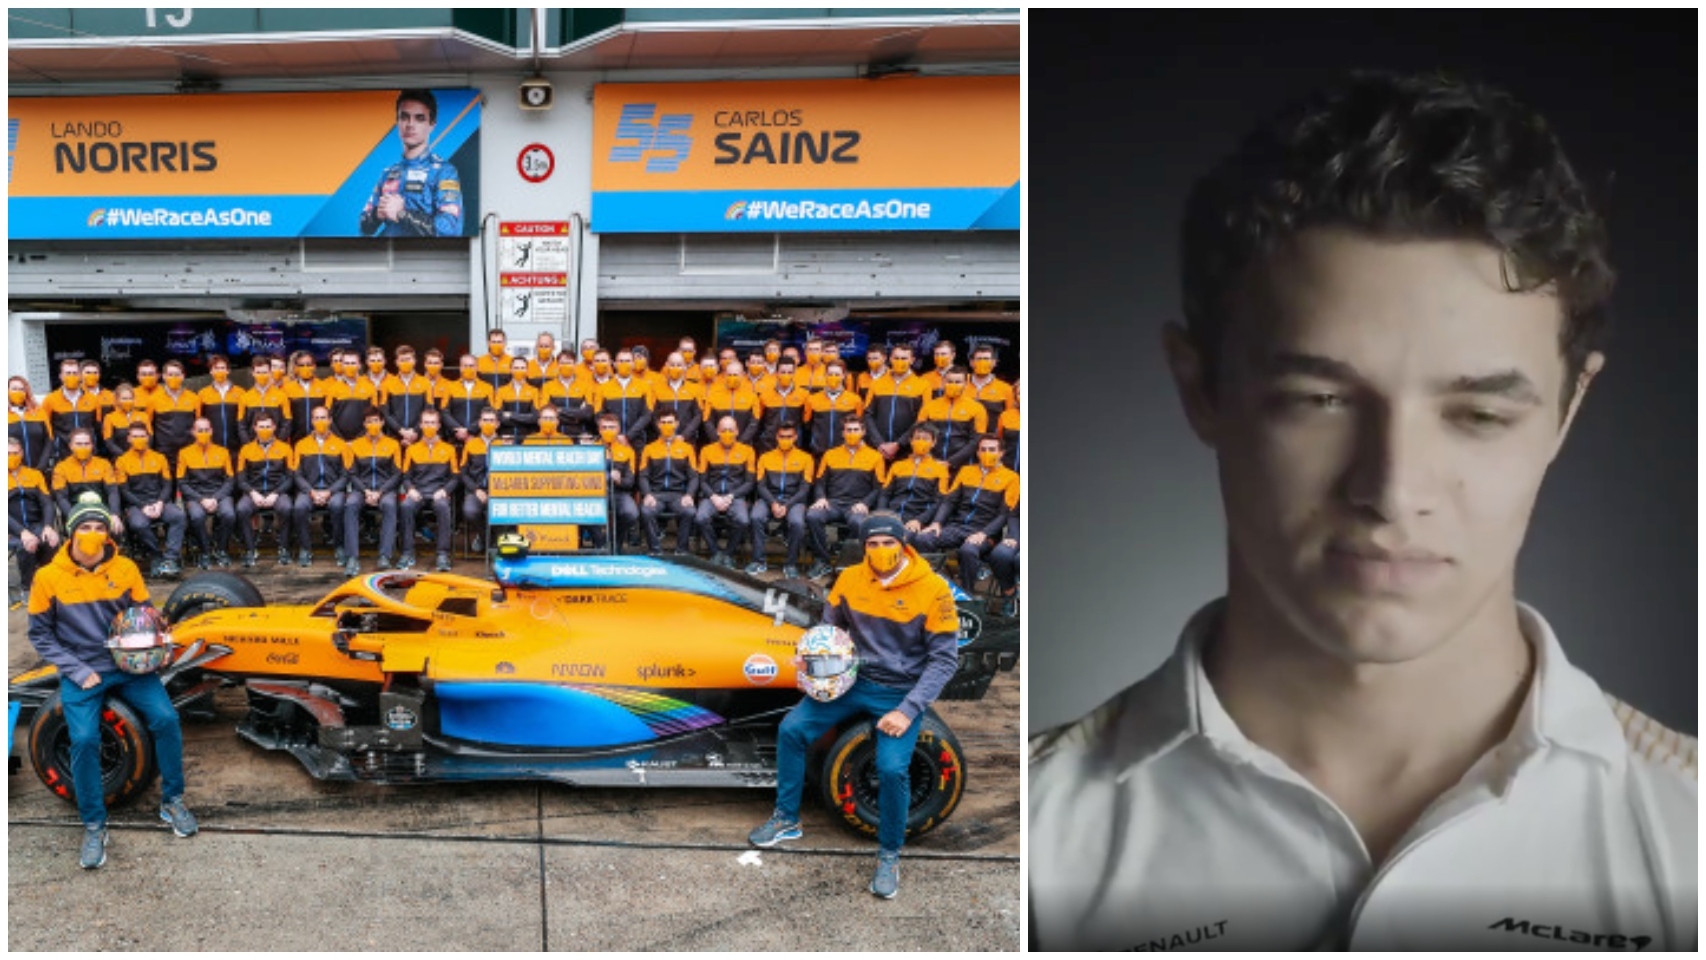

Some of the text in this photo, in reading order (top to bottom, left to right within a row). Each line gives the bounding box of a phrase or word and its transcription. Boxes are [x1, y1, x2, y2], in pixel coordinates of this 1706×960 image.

[714, 109, 803, 127] CARLOS
[51, 121, 122, 138] LANDO
[608, 103, 695, 174] 55
[714, 130, 861, 165] SAINZ
[55, 141, 218, 174] NORRIS
[106, 208, 272, 227] #WeRaceAsOne
[746, 200, 931, 219] #WeRaceAsOne
[514, 224, 556, 233] CAUTION
[510, 276, 558, 285] ACHTUNG
[523, 450, 553, 466] MENTAL
[555, 450, 586, 466] HEALTH
[492, 502, 604, 518] FOR BETTER MENTAL HEALTH
[551, 565, 668, 579] DELL Technologies
[763, 588, 789, 626] 4
